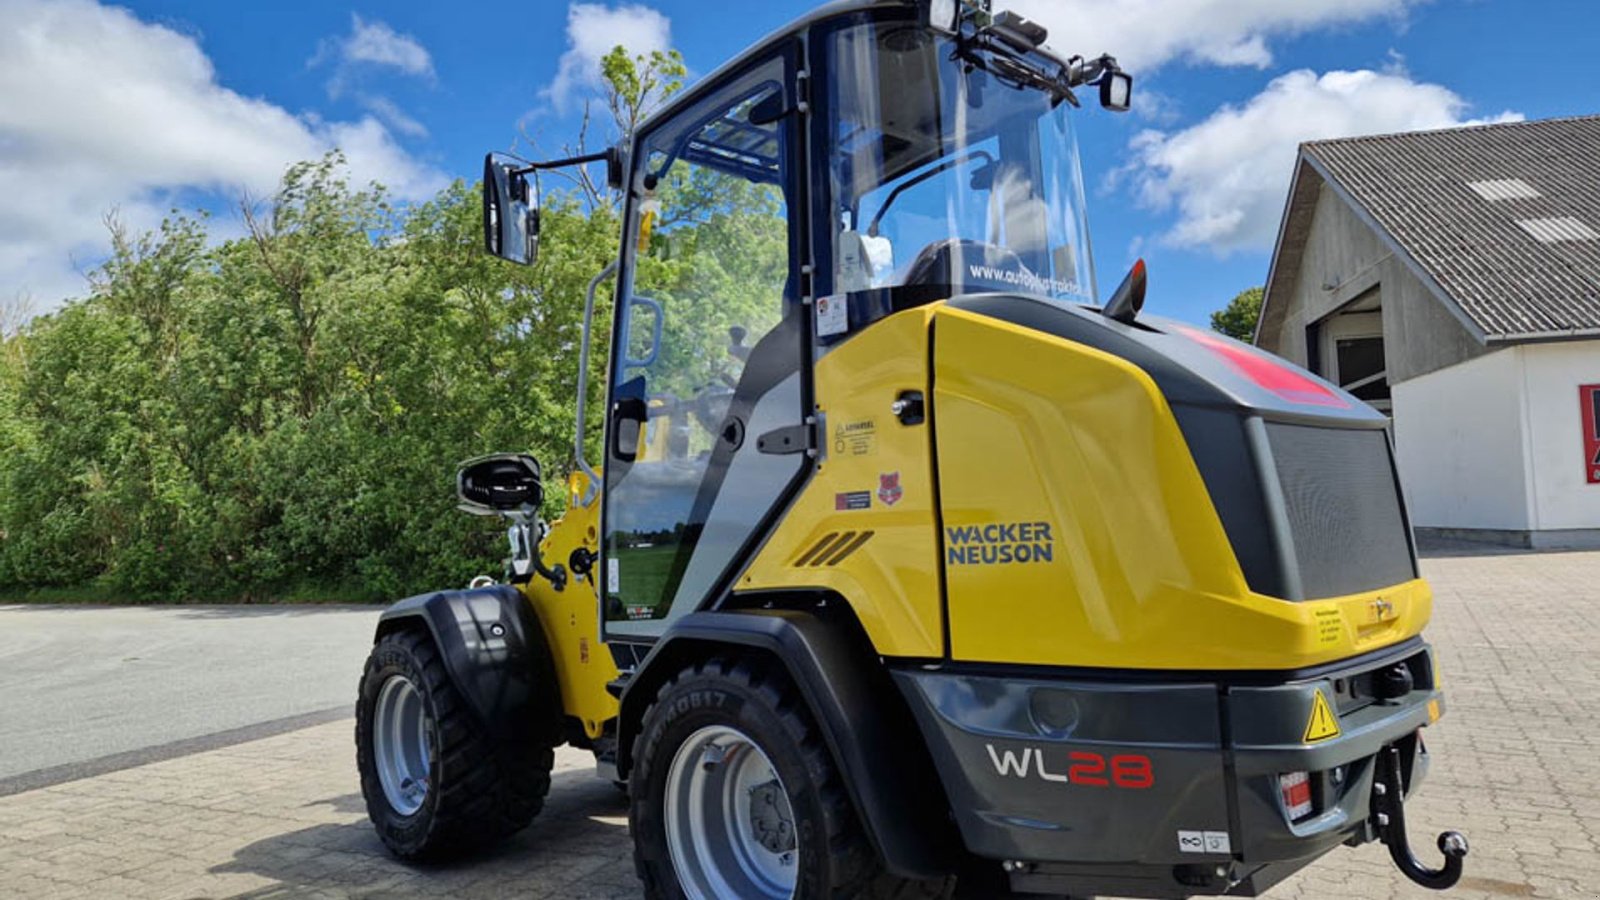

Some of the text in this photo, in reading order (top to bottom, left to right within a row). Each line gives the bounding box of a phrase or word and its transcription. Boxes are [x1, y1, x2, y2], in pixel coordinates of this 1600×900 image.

[946, 522, 1053, 544] WACKER
[948, 543, 1053, 564] NEUSON
[985, 744, 1155, 789] WL28
